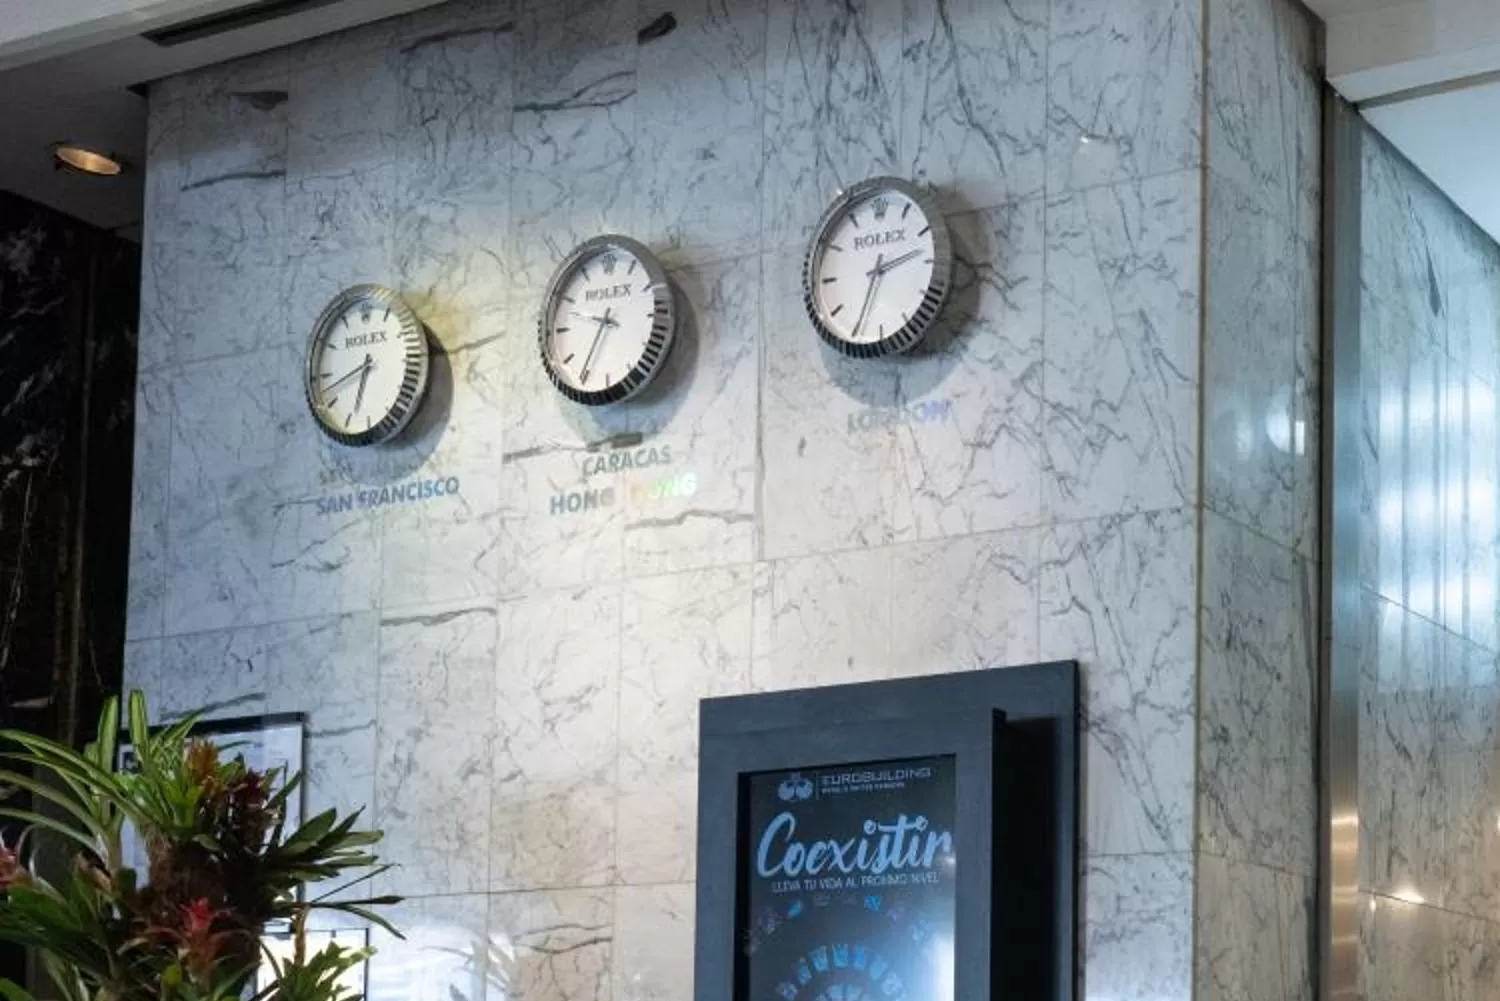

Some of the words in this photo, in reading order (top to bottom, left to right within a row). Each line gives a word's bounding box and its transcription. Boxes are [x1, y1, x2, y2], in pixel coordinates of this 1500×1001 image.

[853, 228, 906, 250] ROLEX
[585, 283, 632, 301] ROLEX
[345, 330, 388, 348] ROLEX
[582, 444, 671, 477] CARACAS
[316, 493, 352, 516] SAN
[359, 476, 461, 506] FRANCISCO
